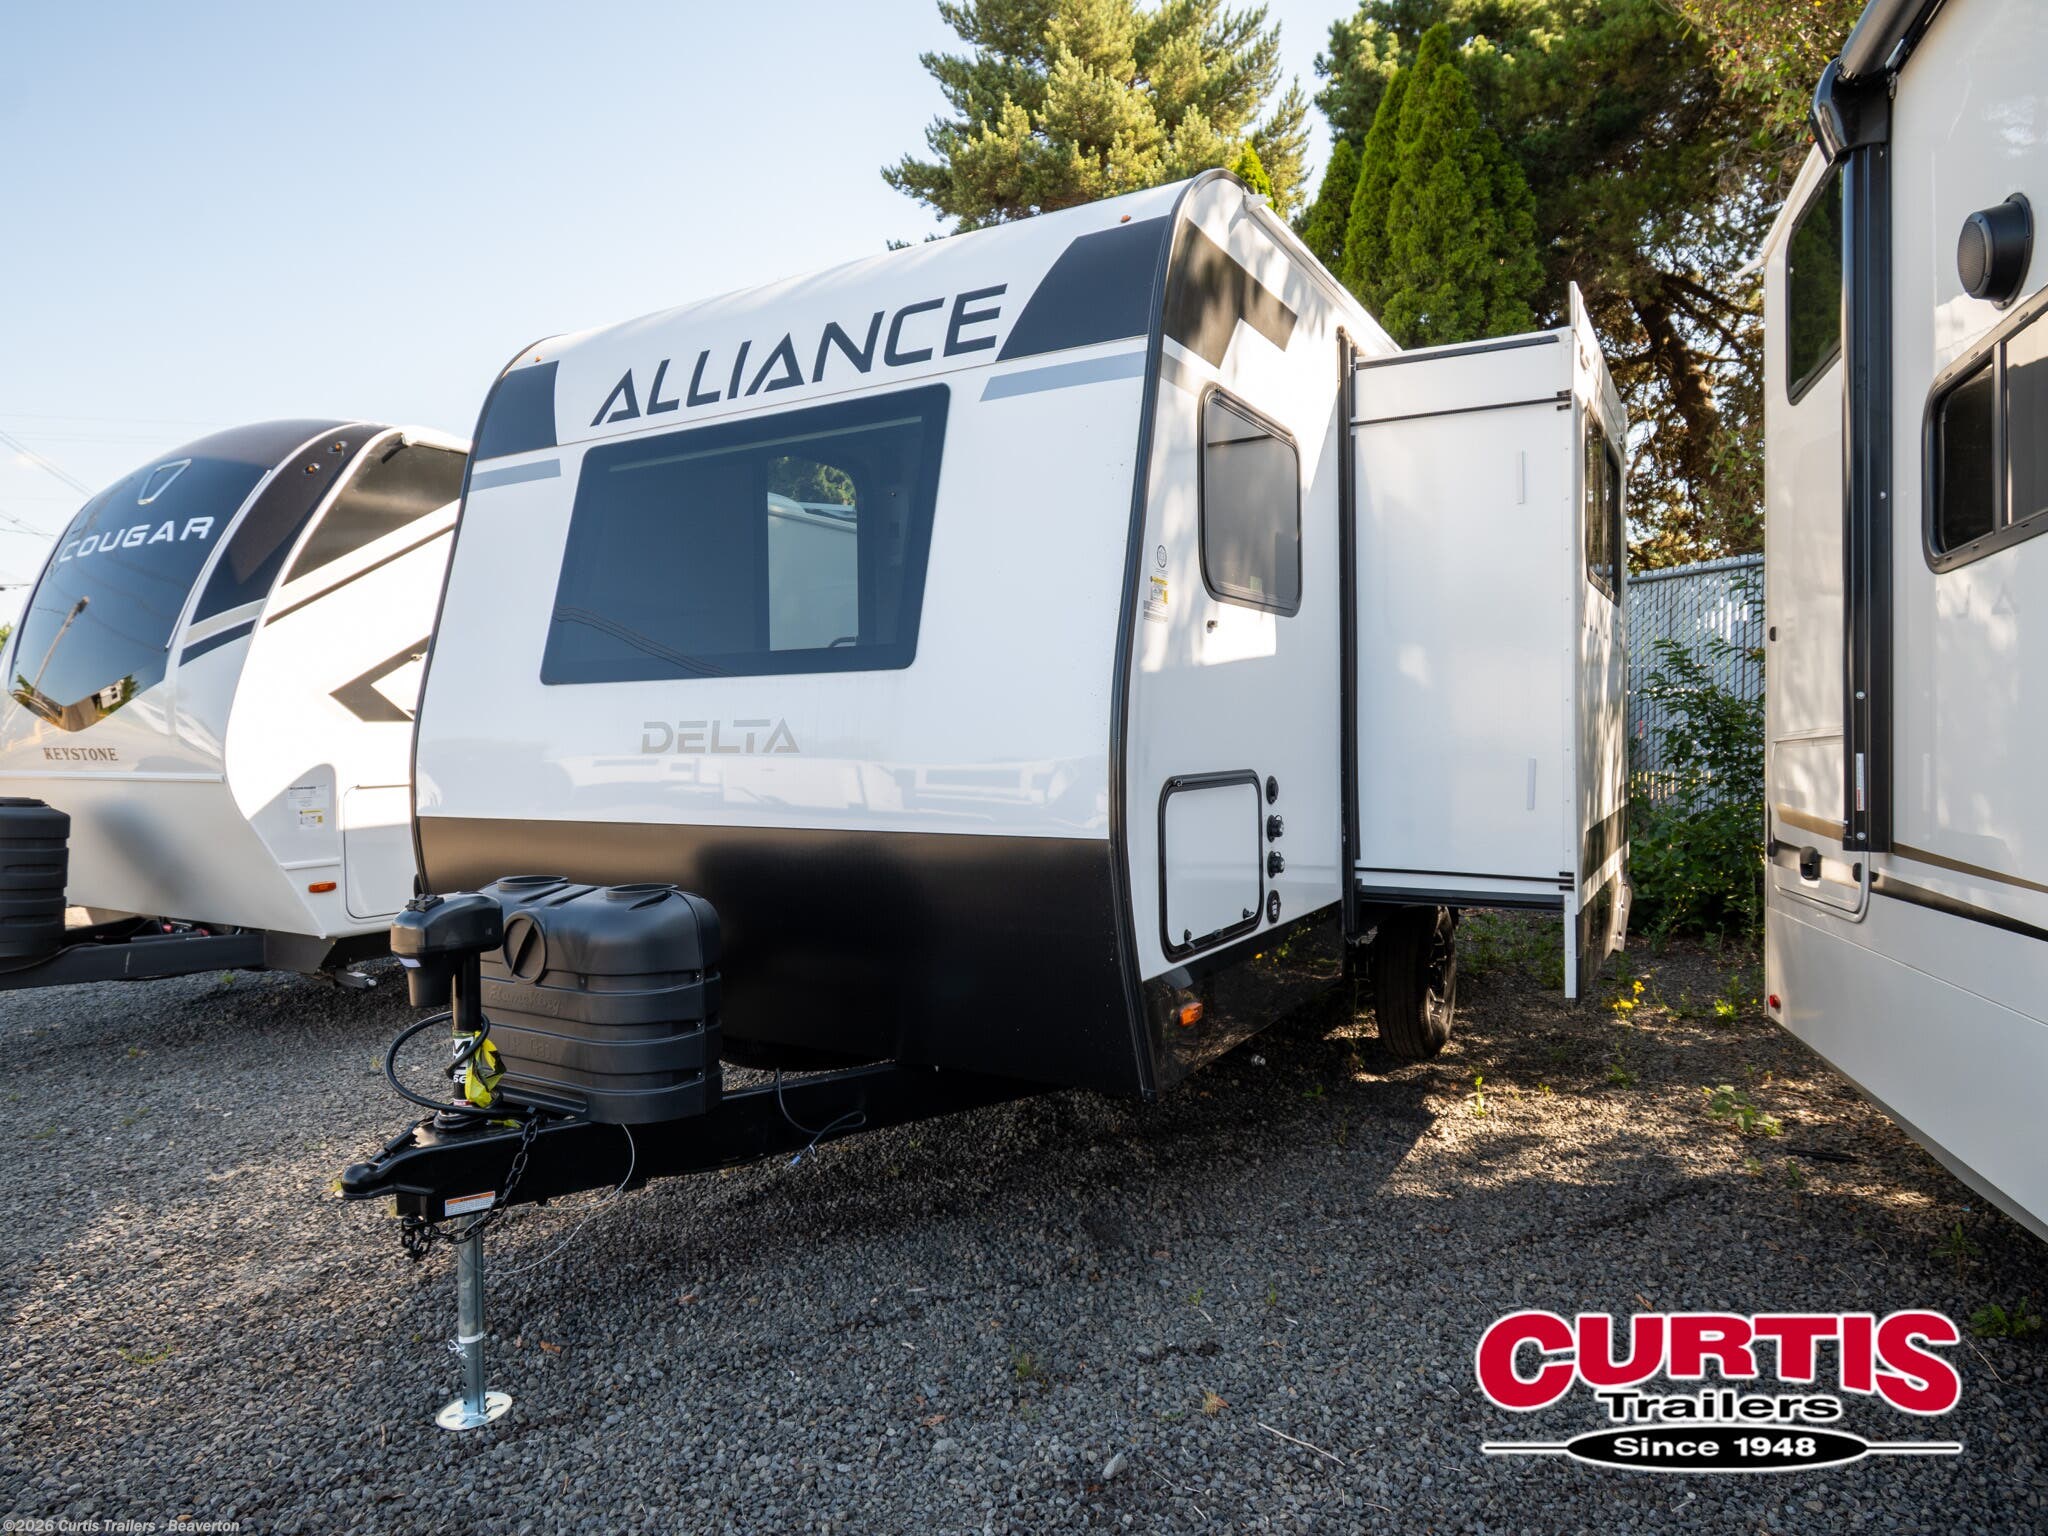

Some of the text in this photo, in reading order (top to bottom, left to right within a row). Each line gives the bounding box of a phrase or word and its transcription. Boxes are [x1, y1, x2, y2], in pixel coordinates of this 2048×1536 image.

[589, 283, 1008, 428] ALLIANCE
[58, 516, 215, 563] COUGAR
[43, 747, 119, 761] KEYSTONE
[641, 717, 801, 754] DELTA
